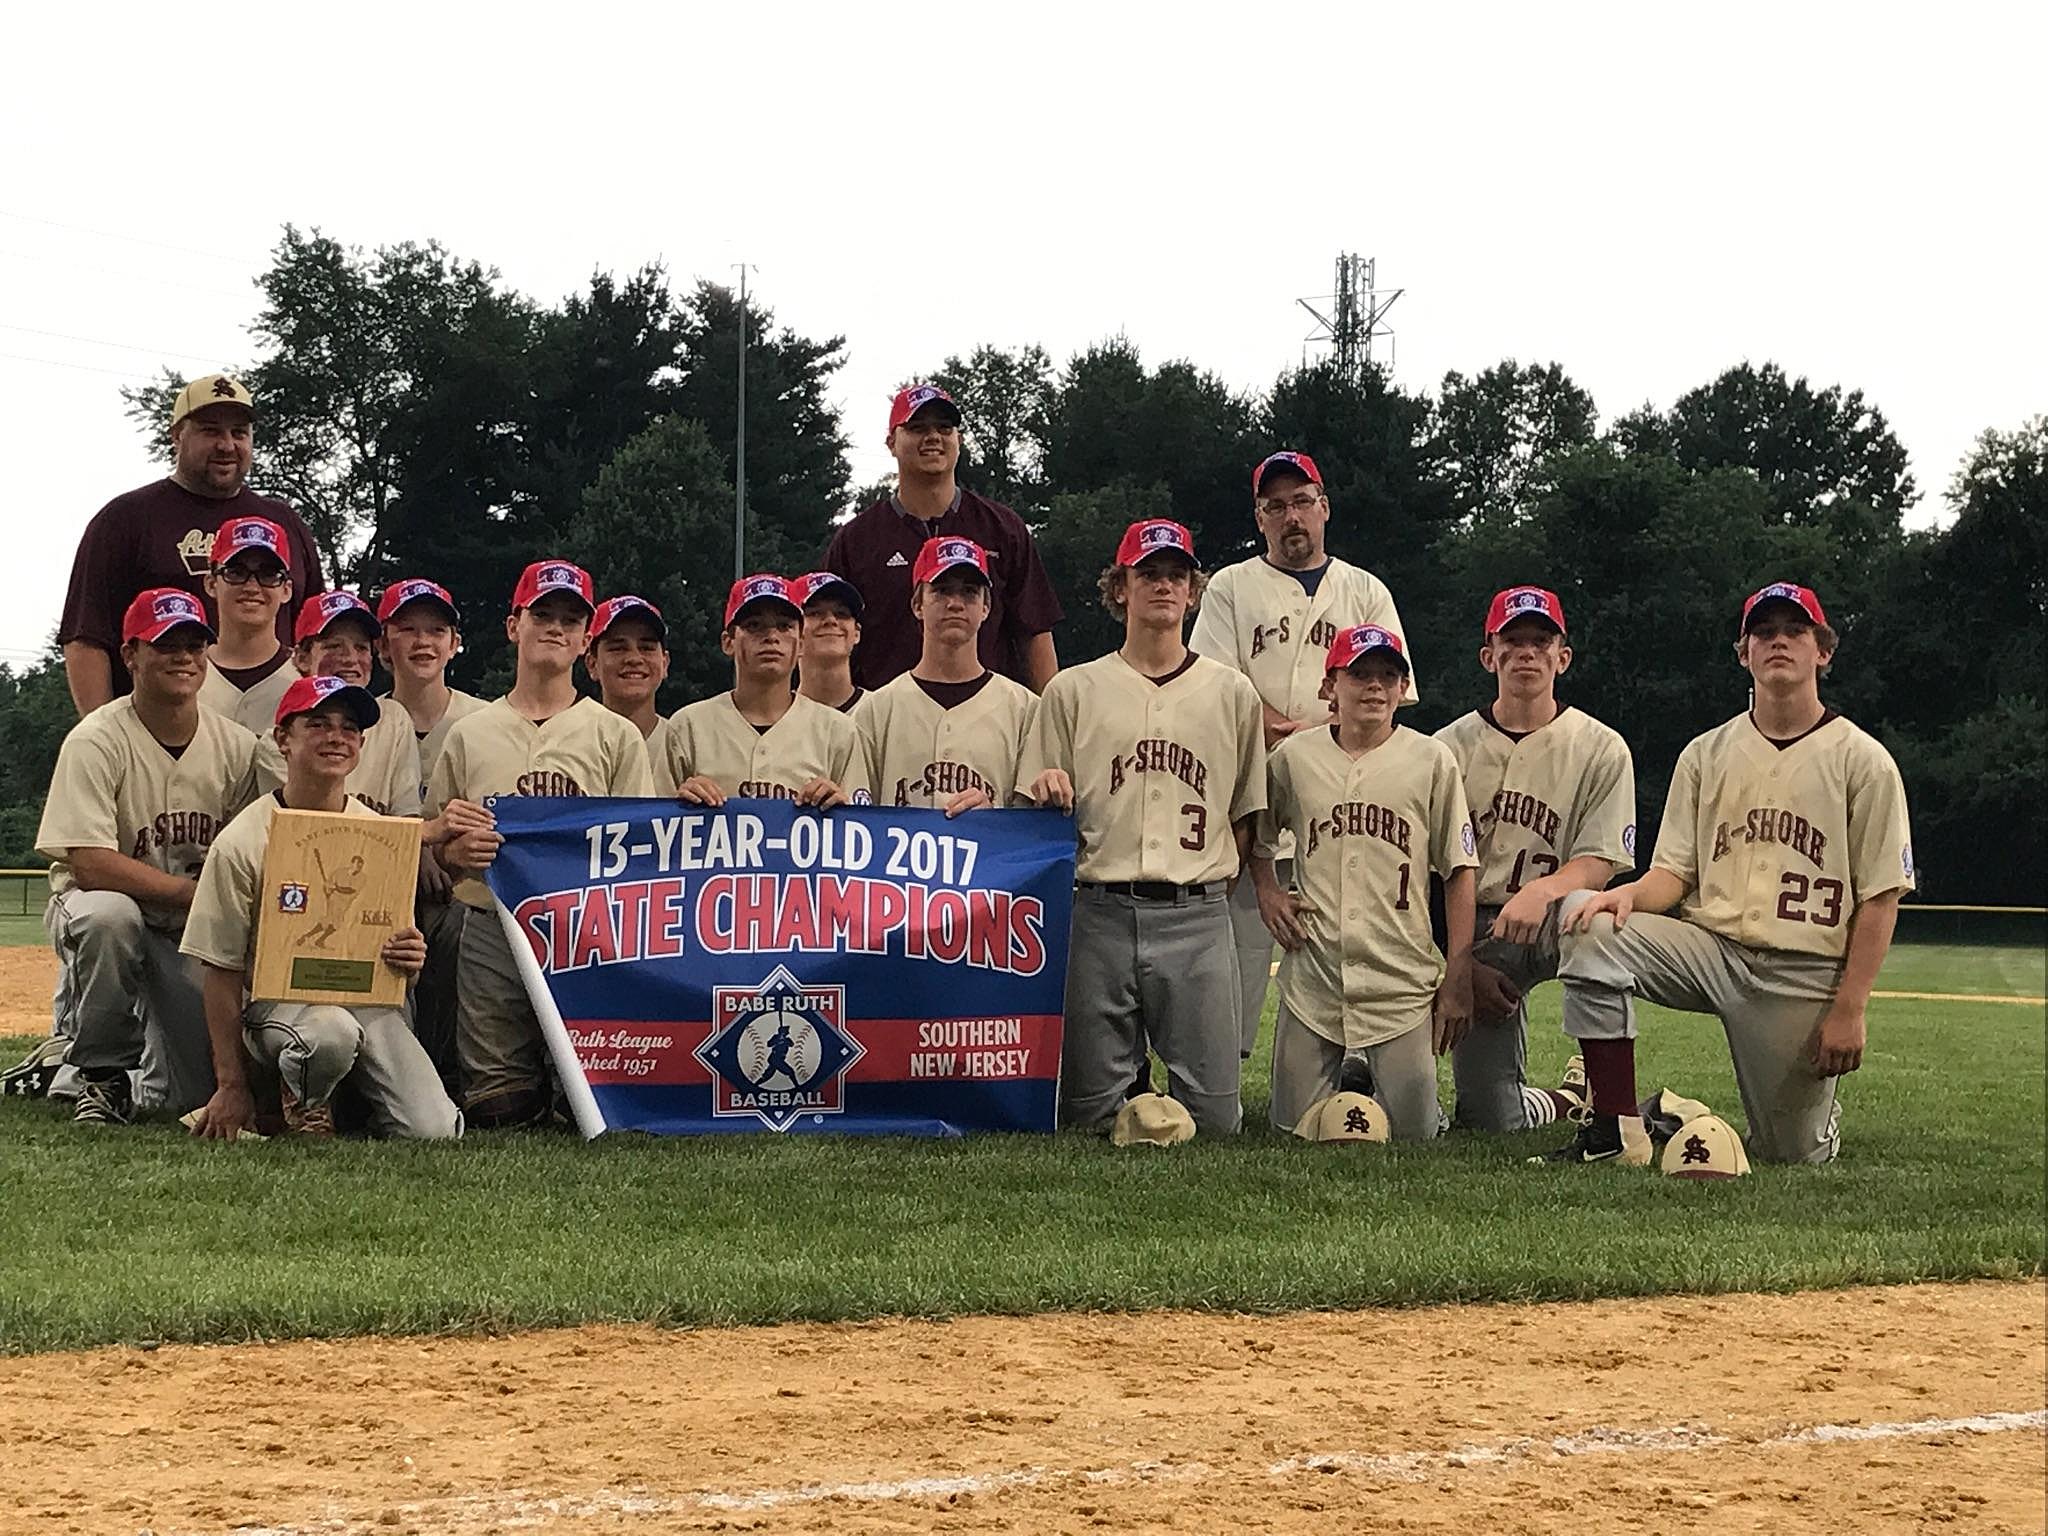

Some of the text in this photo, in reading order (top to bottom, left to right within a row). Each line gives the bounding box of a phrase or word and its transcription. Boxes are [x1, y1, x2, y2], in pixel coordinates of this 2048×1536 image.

[1109, 739, 1208, 802] A-SHORE
[585, 814, 979, 886] 13-YEAR-OLD 2017
[1179, 803, 1207, 852] 3
[1712, 808, 1828, 871] A-SHORE
[1394, 863, 1410, 910] 1
[1776, 871, 1844, 928] 23
[512, 873, 1047, 977] STATE CHAMPIONS
[725, 995, 834, 1012] BABE RUTH
[609, 1029, 673, 1055] League
[919, 1018, 1021, 1048] SOUTHERN
[623, 1058, 658, 1076] 1951
[910, 1049, 1030, 1077] NEW JERSEY
[730, 1092, 826, 1108] BASEBALL
